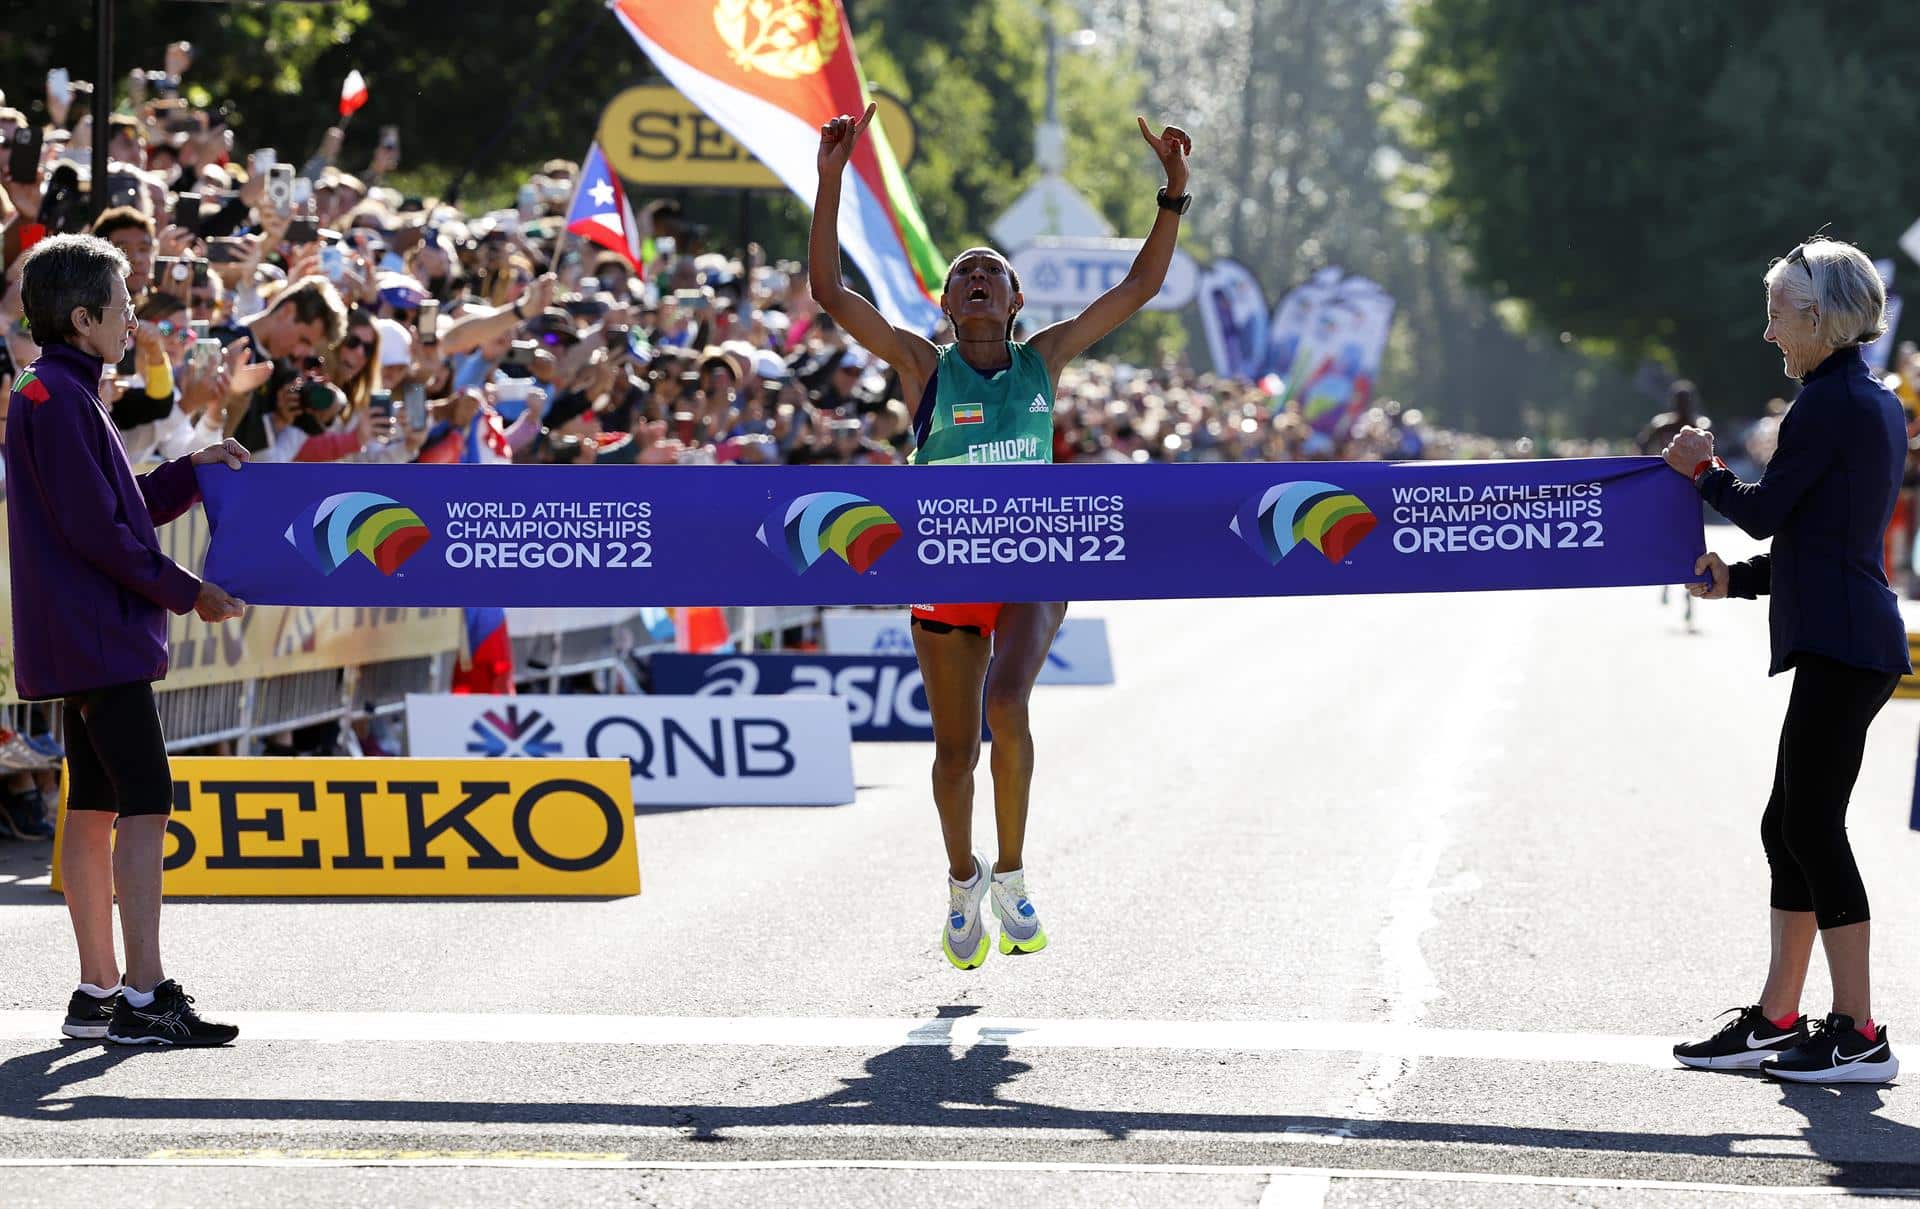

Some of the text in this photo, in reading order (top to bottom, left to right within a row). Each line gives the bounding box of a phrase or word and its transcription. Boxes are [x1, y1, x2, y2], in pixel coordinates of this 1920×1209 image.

[630, 111, 760, 160] SE
[968, 437, 1037, 464] ETHIOPIA
[1392, 482, 1603, 504] WORLD ATHLETICS
[446, 502, 652, 518] WORLD ATHLETICS
[917, 495, 1124, 515] WORLD ATHLETICS
[1393, 499, 1603, 524] CHAMPIONSHIPS
[446, 521, 652, 539] CHAMPIONSHIPS
[917, 514, 1125, 535] CHAMPIONSHIPS
[786, 666, 934, 727] asic
[585, 716, 796, 780] QNB
